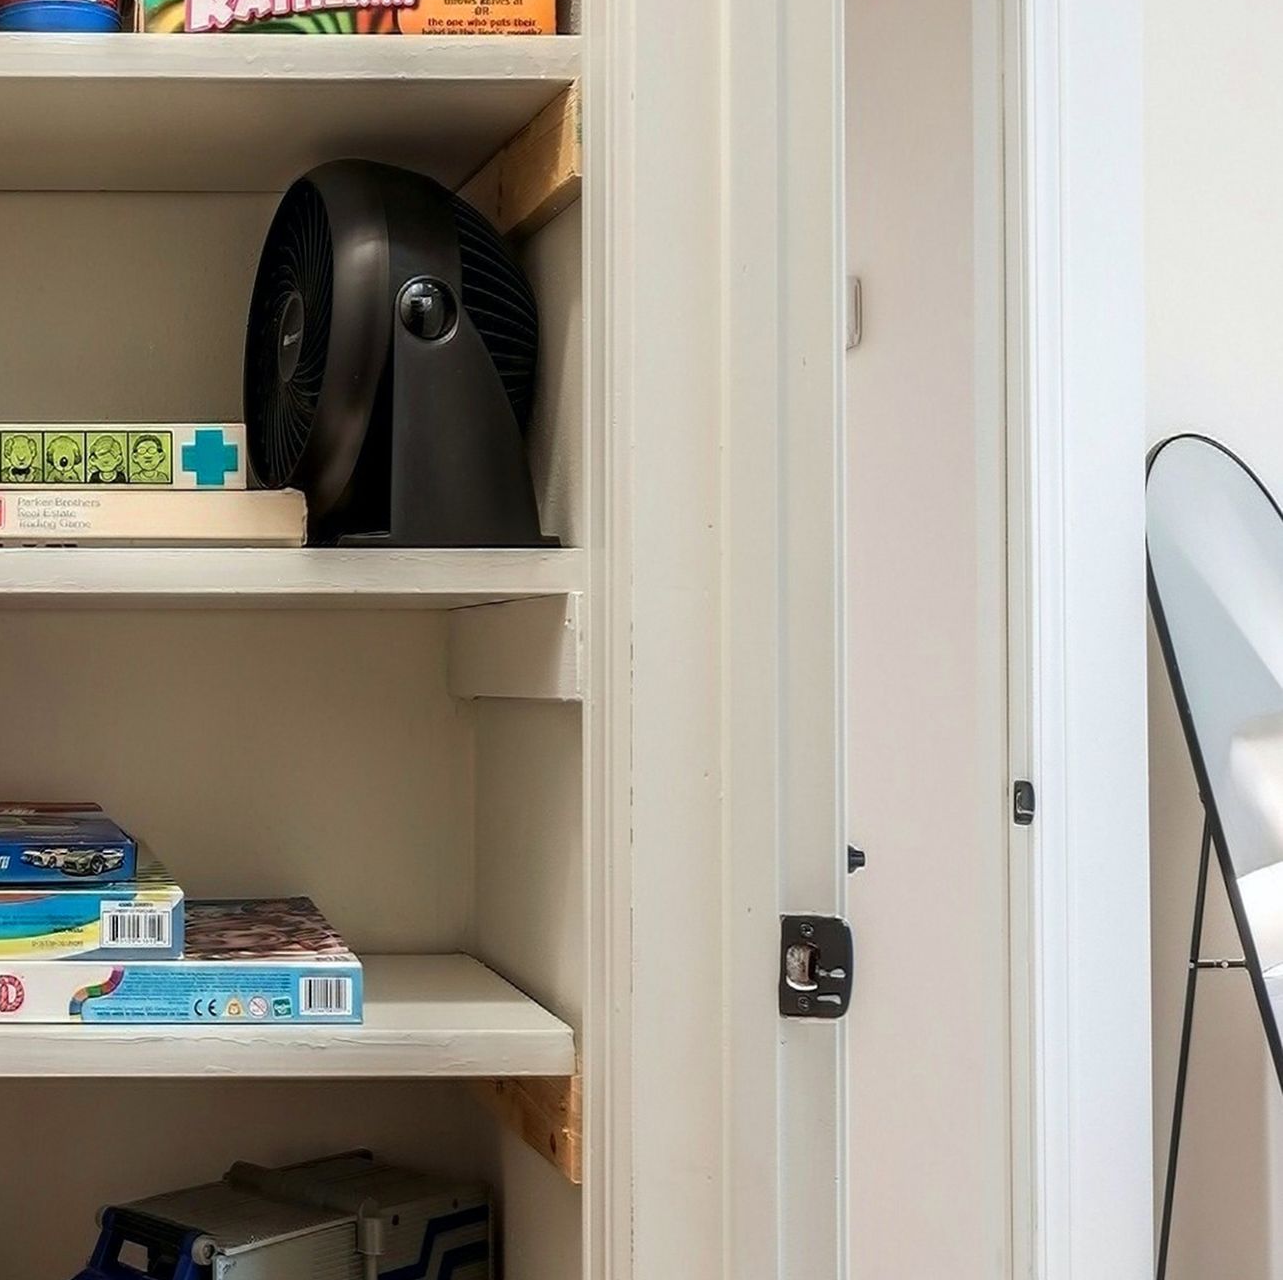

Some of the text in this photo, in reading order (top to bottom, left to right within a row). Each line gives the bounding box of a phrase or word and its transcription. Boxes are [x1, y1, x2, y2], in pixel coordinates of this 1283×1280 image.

[428, 18, 443, 26] the
[467, 18, 487, 26] who
[490, 18, 511, 28] puts
[514, 17, 536, 27] their
[18, 497, 101, 507] Parker Brothers
